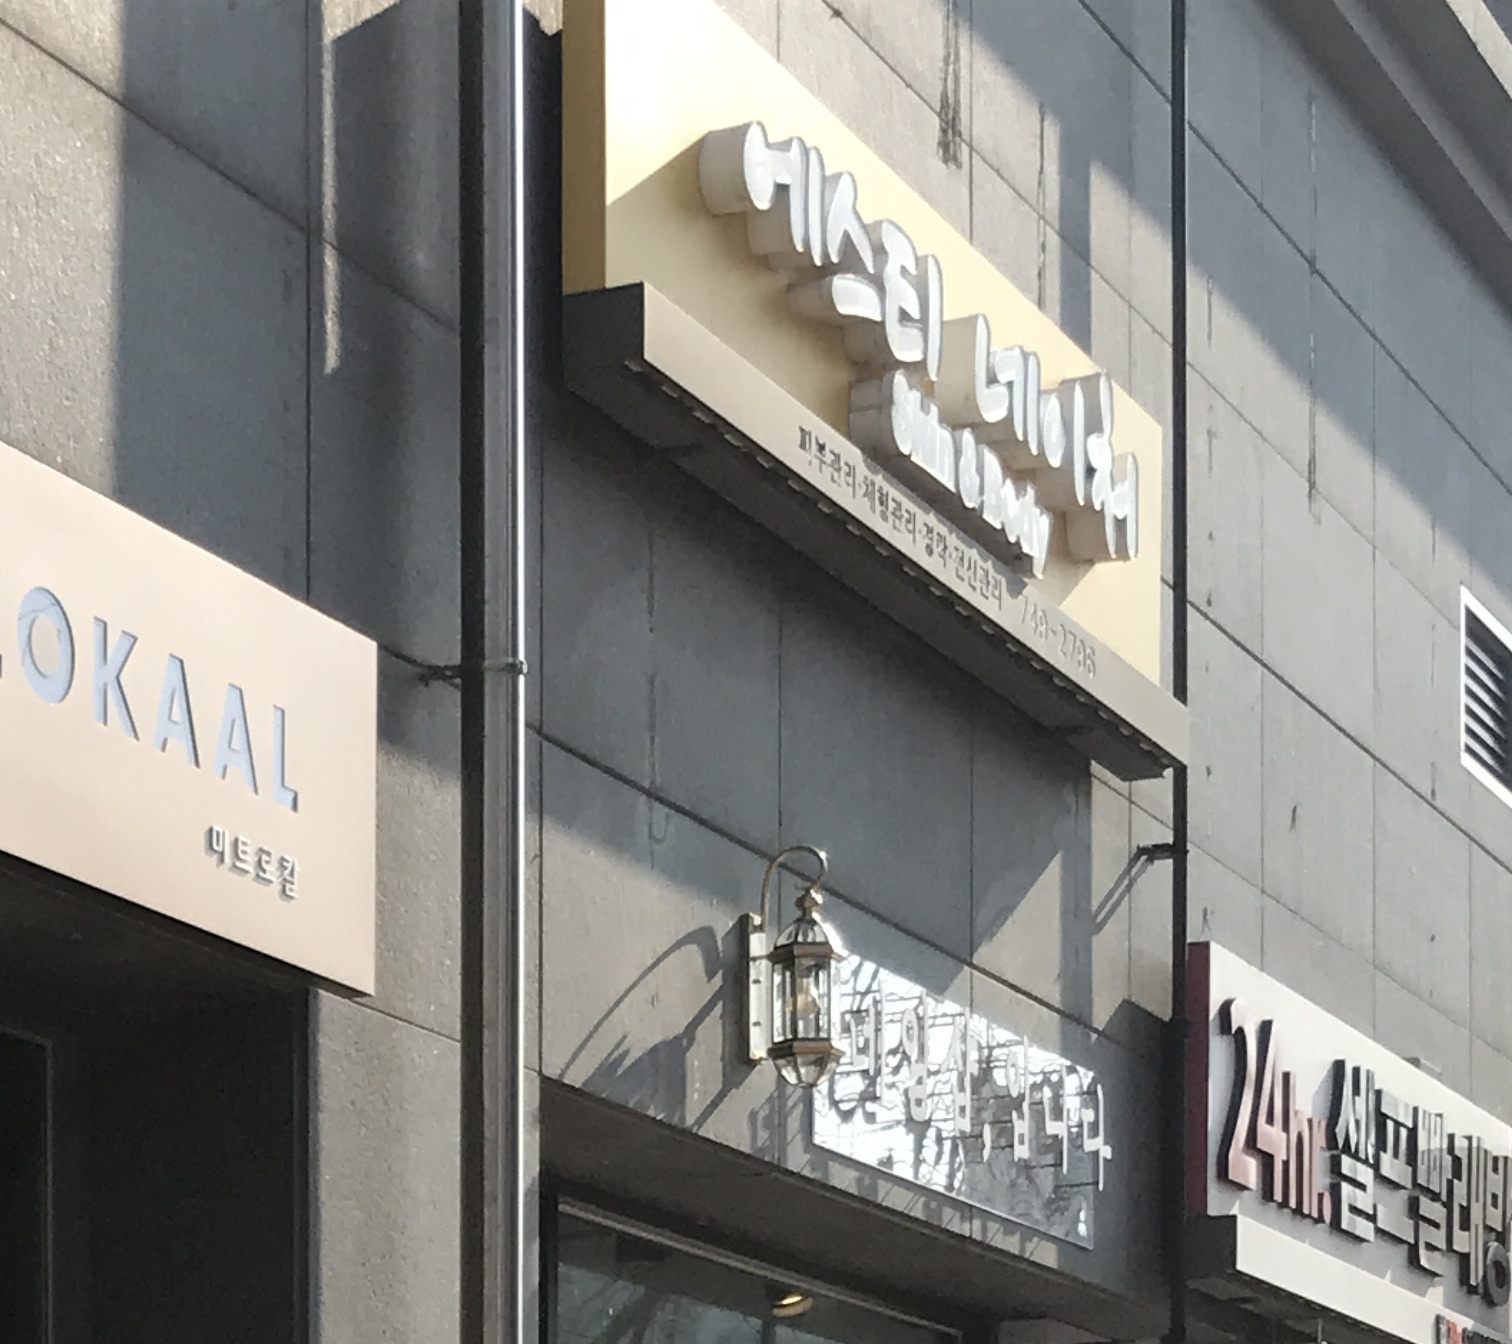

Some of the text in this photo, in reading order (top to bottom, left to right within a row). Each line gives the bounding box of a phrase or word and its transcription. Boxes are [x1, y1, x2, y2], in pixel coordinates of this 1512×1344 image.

[743, 121, 1139, 561] 에스티 네이처
[205, 824, 300, 902] 미트로칼
[1221, 997, 1512, 1307] 24hr. 셀프빨래방
